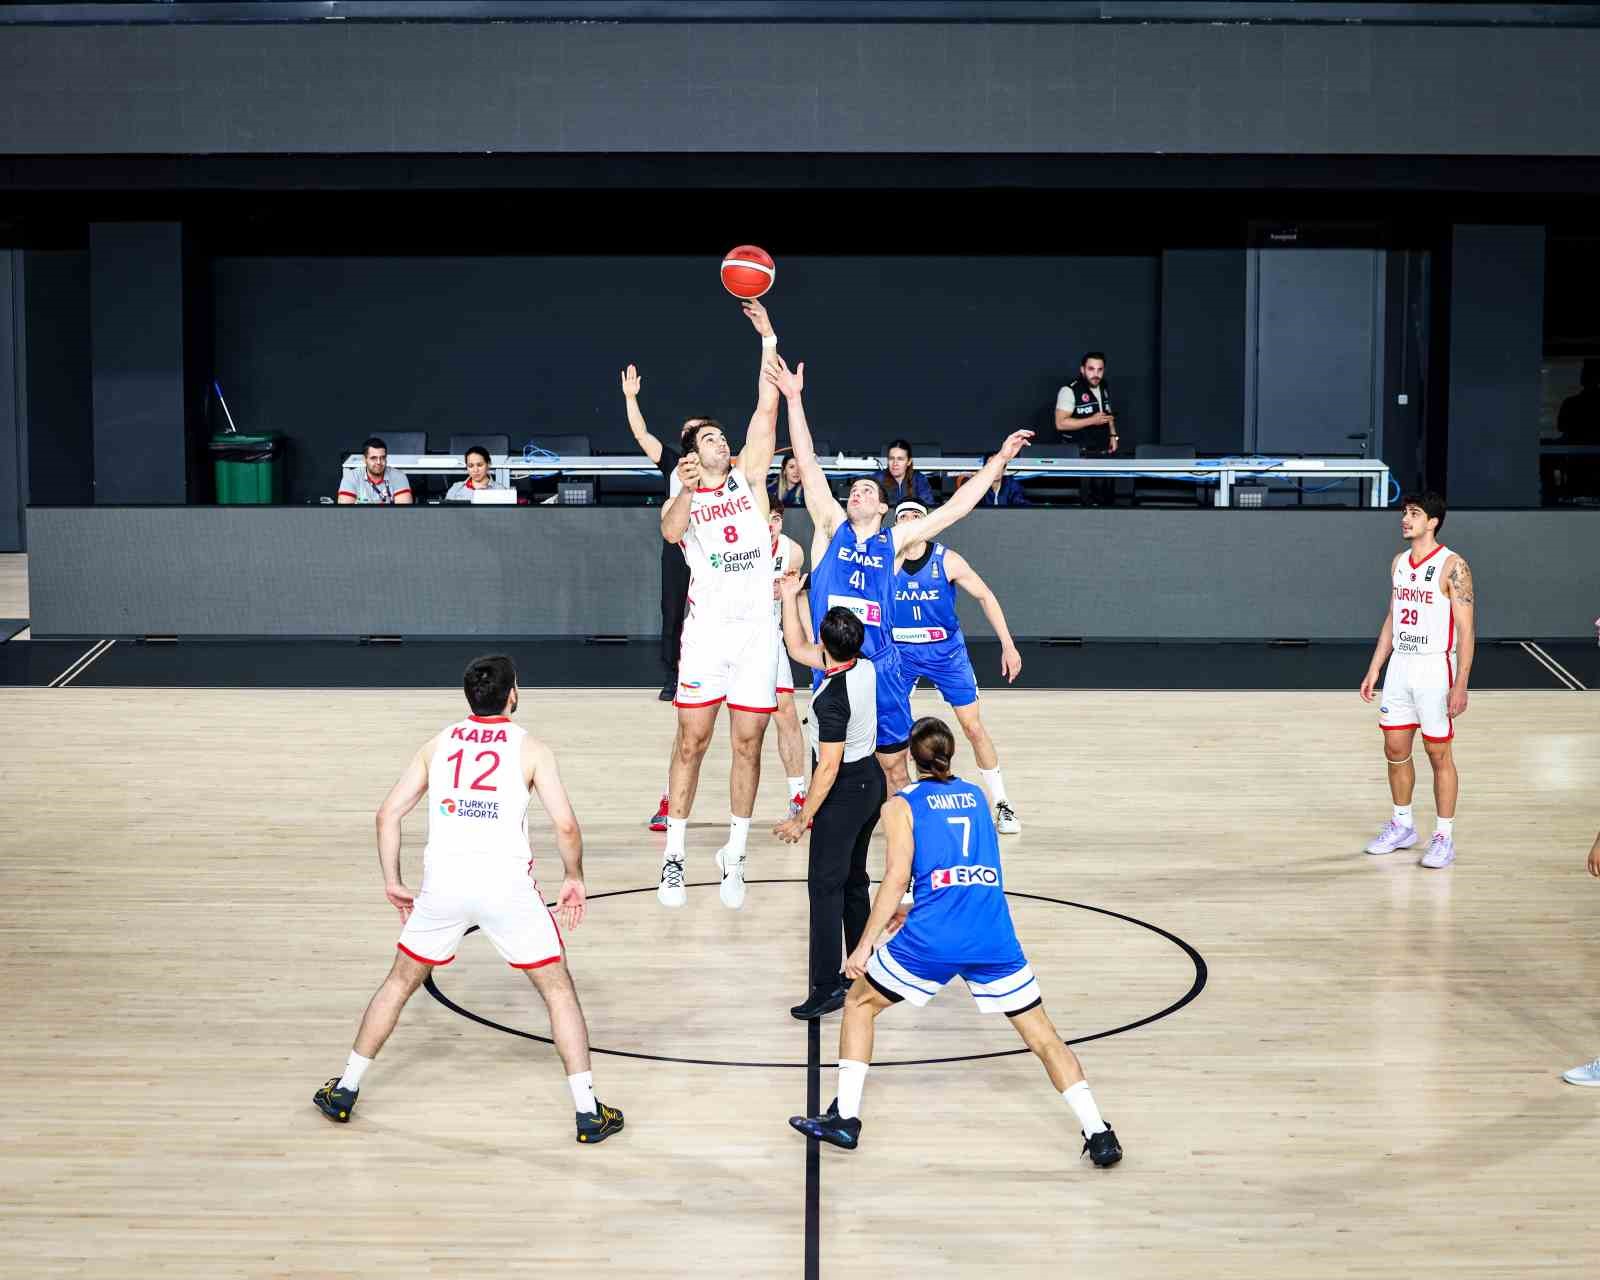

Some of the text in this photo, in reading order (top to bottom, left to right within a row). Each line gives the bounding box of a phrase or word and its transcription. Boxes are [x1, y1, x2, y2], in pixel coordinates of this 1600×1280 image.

[691, 496, 751, 525] TÜRKİYE
[723, 525, 738, 543] 8
[723, 548, 761, 563] Garanti
[724, 561, 754, 573] BBVA
[849, 570, 865, 590] 41
[1393, 585, 1433, 604] TÜRKİYE
[913, 606, 921, 621] 11
[1400, 608, 1418, 625] 29
[1400, 632, 1428, 645] Garanti
[451, 728, 507, 743] KABA
[447, 749, 500, 791] 12
[927, 793, 976, 809] CHANTZIS
[947, 816, 970, 857] 7
[956, 868, 997, 883] EKO
